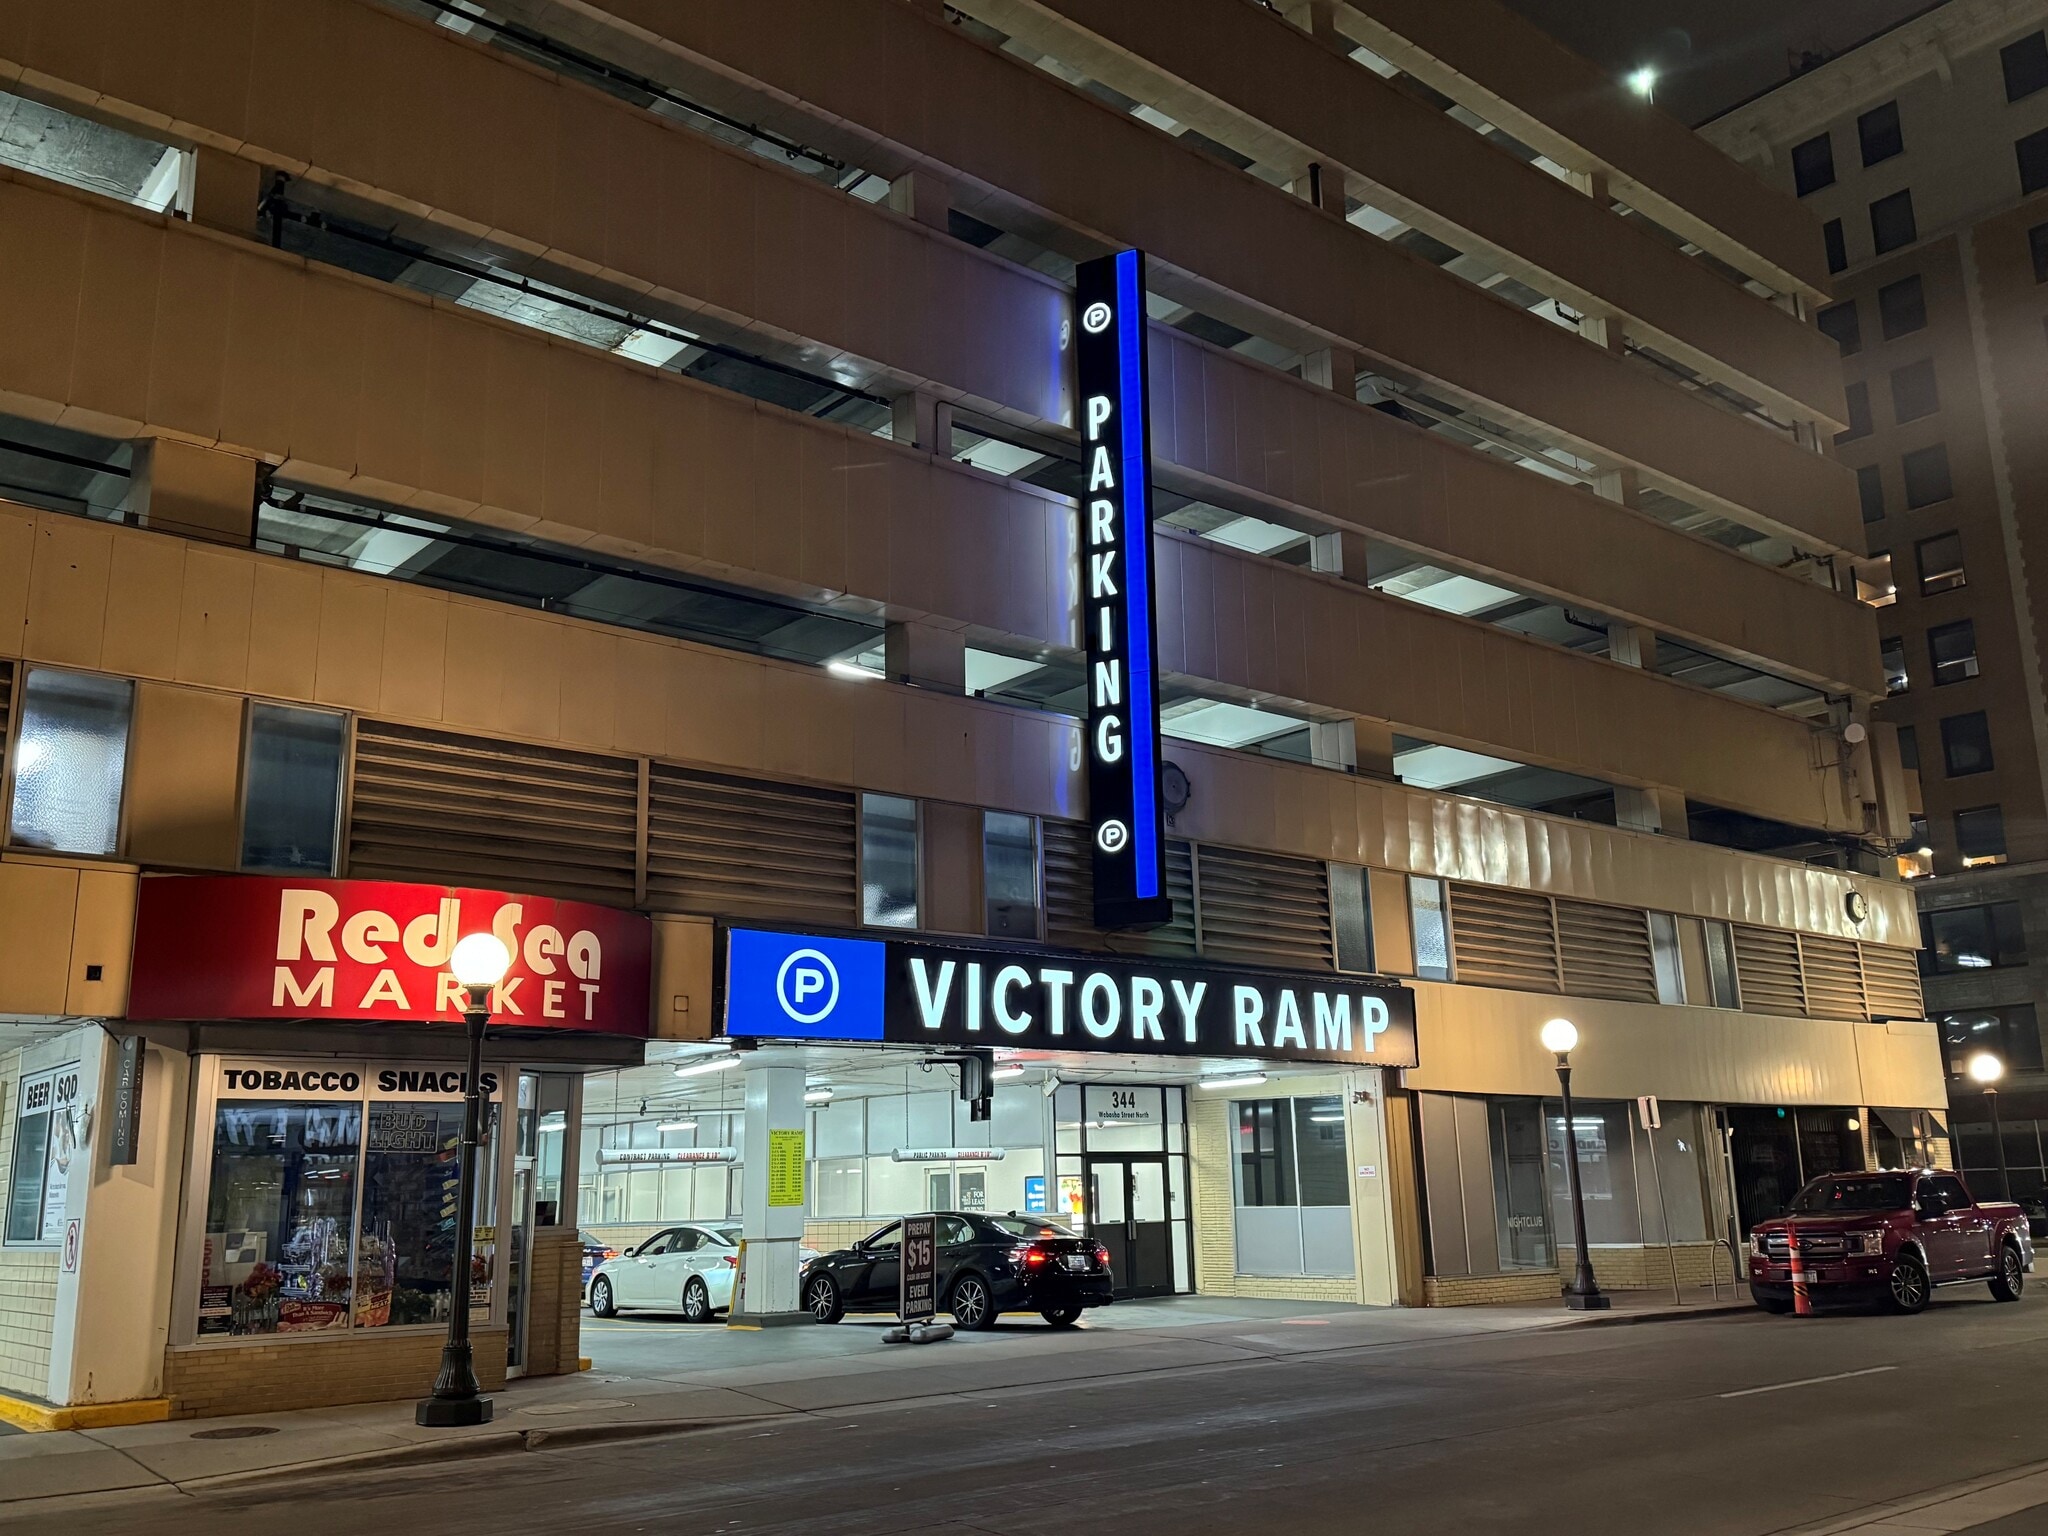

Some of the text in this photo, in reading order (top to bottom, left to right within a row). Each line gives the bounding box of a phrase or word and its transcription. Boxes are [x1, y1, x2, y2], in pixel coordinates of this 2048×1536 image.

[1087, 395, 1123, 764] PARKING
[275, 888, 601, 981] Red Sea
[272, 965, 601, 1021] MARKET
[910, 957, 1390, 1053] VICTORY RAMP
[224, 1070, 360, 1093] TOBACCO
[26, 1081, 50, 1110] BEER
[1112, 1091, 1135, 1109] 344
[117, 1091, 128, 1147] COMING
[380, 1111, 427, 1130] BUD
[1098, 1111, 1120, 1119] Wabasha
[369, 1131, 436, 1150] LIGHT
[619, 1153, 646, 1161] CONTRACT
[908, 1222, 931, 1236] PREPAY
[1507, 1216, 1543, 1228] NIGHTCLUB
[908, 1240, 931, 1270] $15
[909, 1284, 929, 1298] EVENT
[906, 1298, 932, 1314] PARKING
